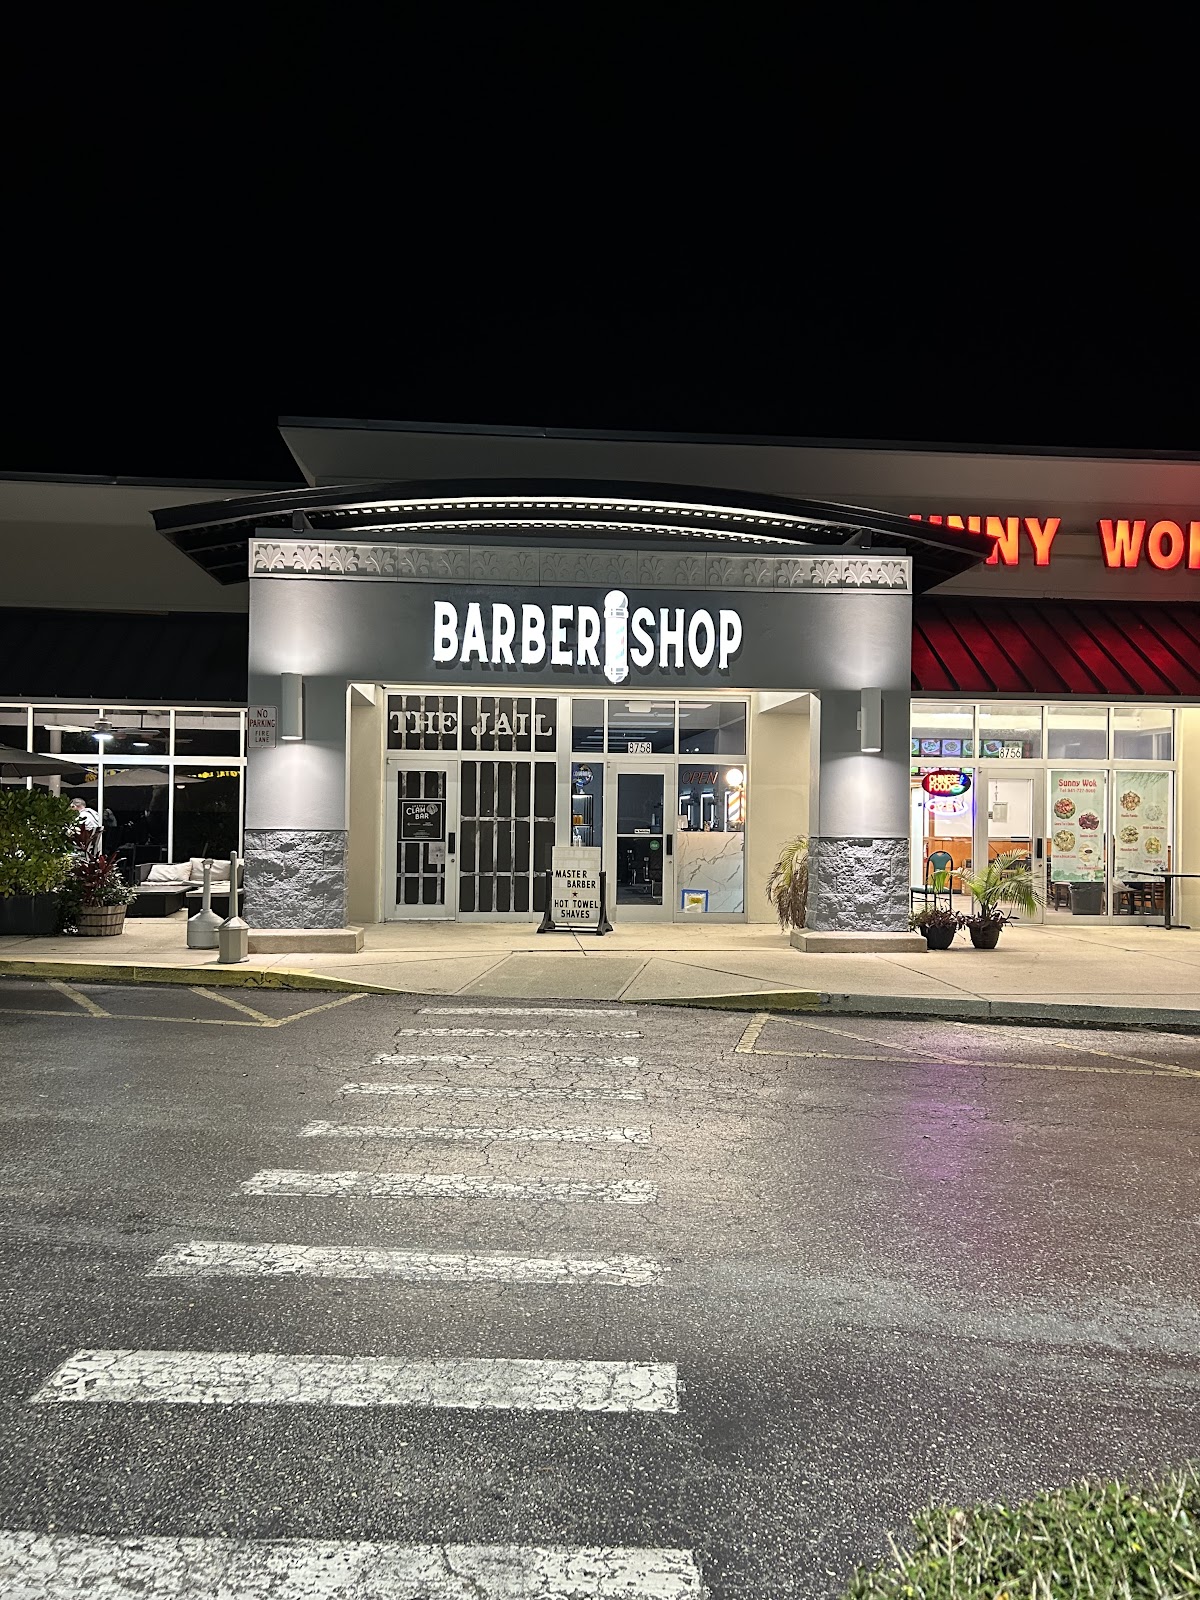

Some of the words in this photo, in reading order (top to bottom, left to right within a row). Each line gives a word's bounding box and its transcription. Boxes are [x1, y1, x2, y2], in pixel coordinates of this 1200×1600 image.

[433, 601, 601, 666] BARBER
[630, 607, 743, 669] SHOP
[256, 709, 268, 718] NO
[249, 719, 276, 728] PARKING
[390, 711, 458, 735] THE
[471, 712, 553, 736] JAIL
[629, 742, 651, 753] 8758
[999, 747, 1021, 759] 8756
[682, 771, 719, 784] OPEN
[929, 774, 960, 784] CHINESE
[929, 783, 952, 792] FOOD
[1058, 779, 1080, 787] Sunny
[1082, 779, 1097, 787] Wok
[406, 806, 425, 815] CLAM
[555, 870, 587, 878] MASTER
[567, 880, 596, 888] BARBER
[554, 899, 569, 908] HOT
[573, 900, 598, 908] TOWEL
[561, 910, 590, 918] SHAVES
